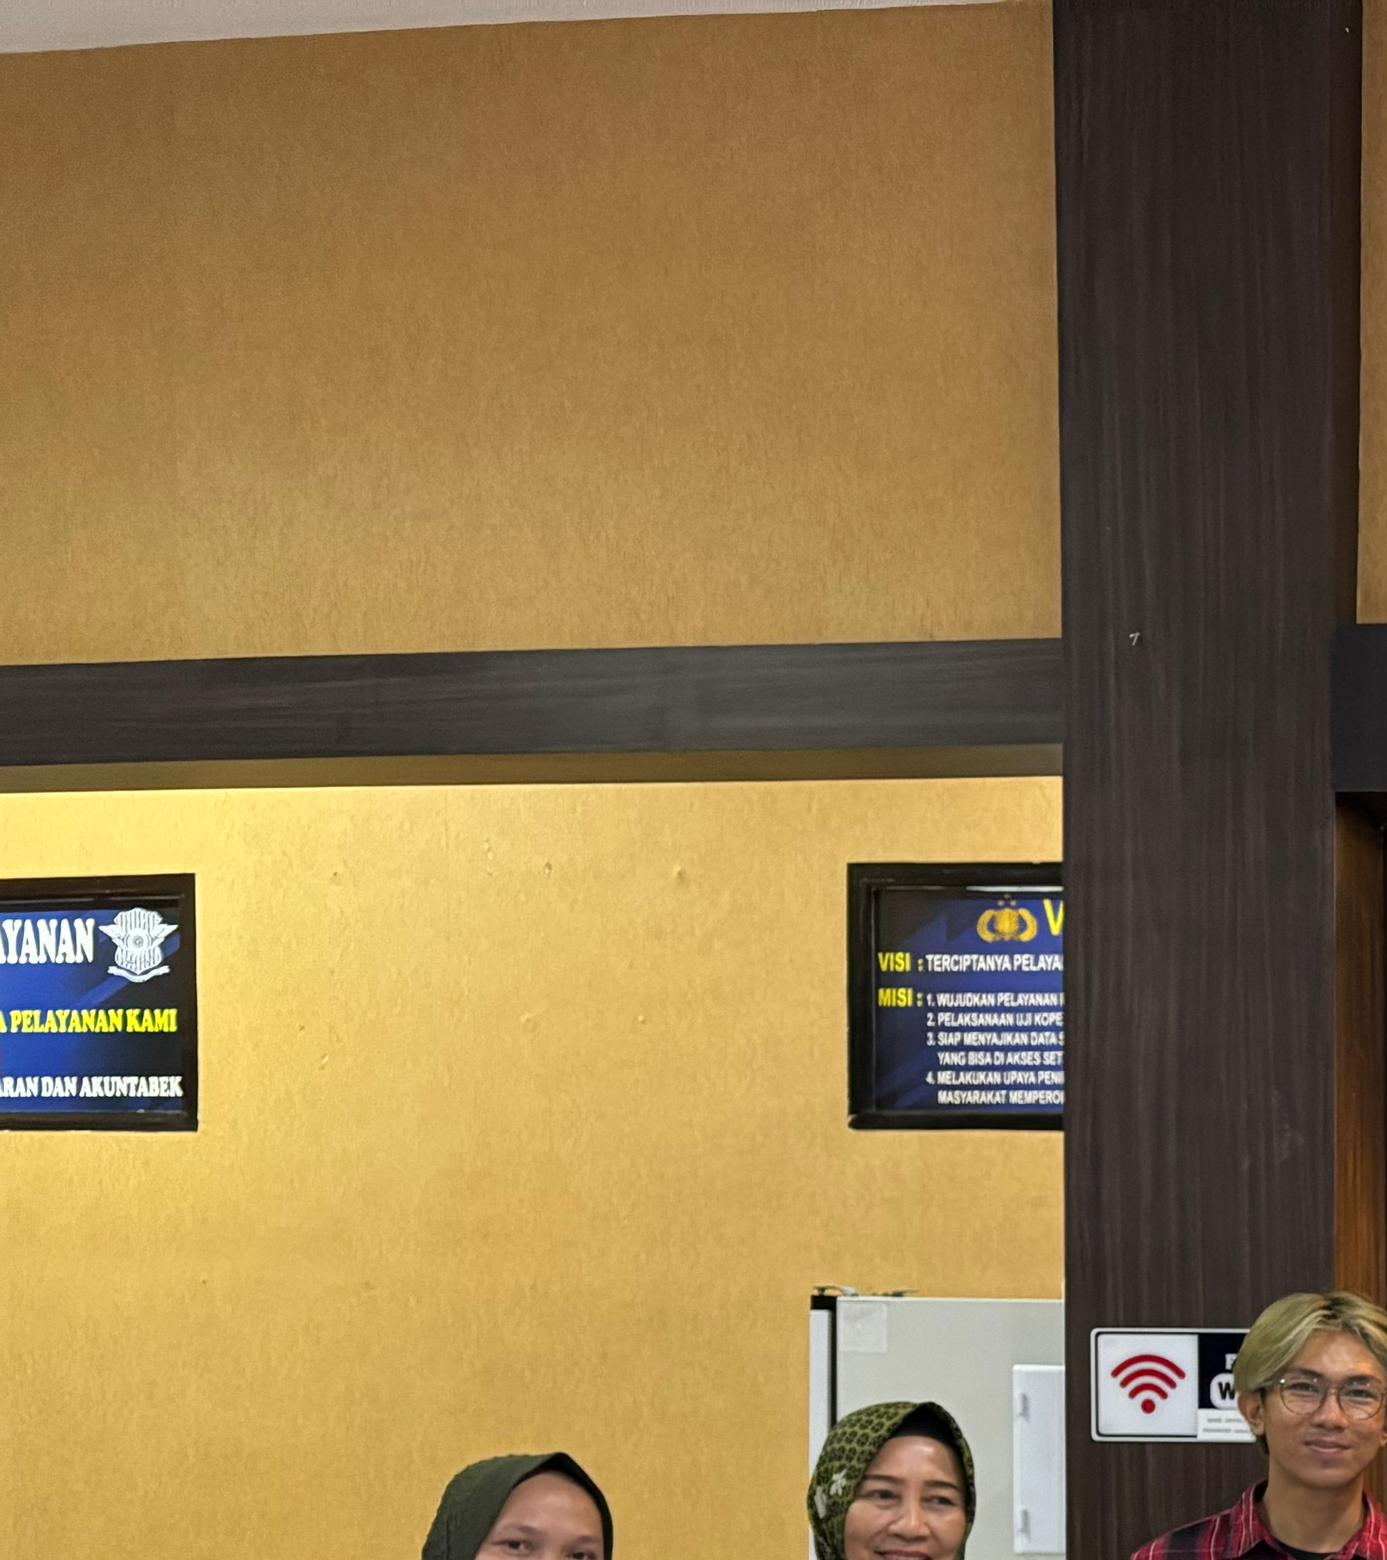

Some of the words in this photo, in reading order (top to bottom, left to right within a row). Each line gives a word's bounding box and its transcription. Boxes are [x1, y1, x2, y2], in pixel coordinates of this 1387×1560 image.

[877, 952, 911, 972] VISI
[925, 953, 1012, 972] TERCIPTANYA
[878, 988, 913, 1007] MISI
[936, 992, 995, 1007] WUJUDKAN
[997, 992, 1059, 1007] PELAYANAN
[10, 1009, 125, 1033] PELAYANAN
[126, 1008, 178, 1032] KAMI
[937, 1012, 1014, 1027] PELAKSANAAN
[1016, 1012, 1033, 1027] UJI
[937, 1031, 962, 1046] SIAP
[963, 1031, 1029, 1046] MENYAJIKAN
[1030, 1031, 1058, 1046] DATA
[937, 1051, 966, 1065] YANG
[967, 1051, 993, 1065] BISA
[994, 1051, 1005, 1065] DI
[1006, 1051, 1041, 1066] AKSES
[937, 1070, 1001, 1085] MELAKUKAN
[1003, 1070, 1036, 1085] UPAYA
[41, 1077, 78, 1097] DAN
[937, 1090, 1007, 1105] MASYARAKAT
